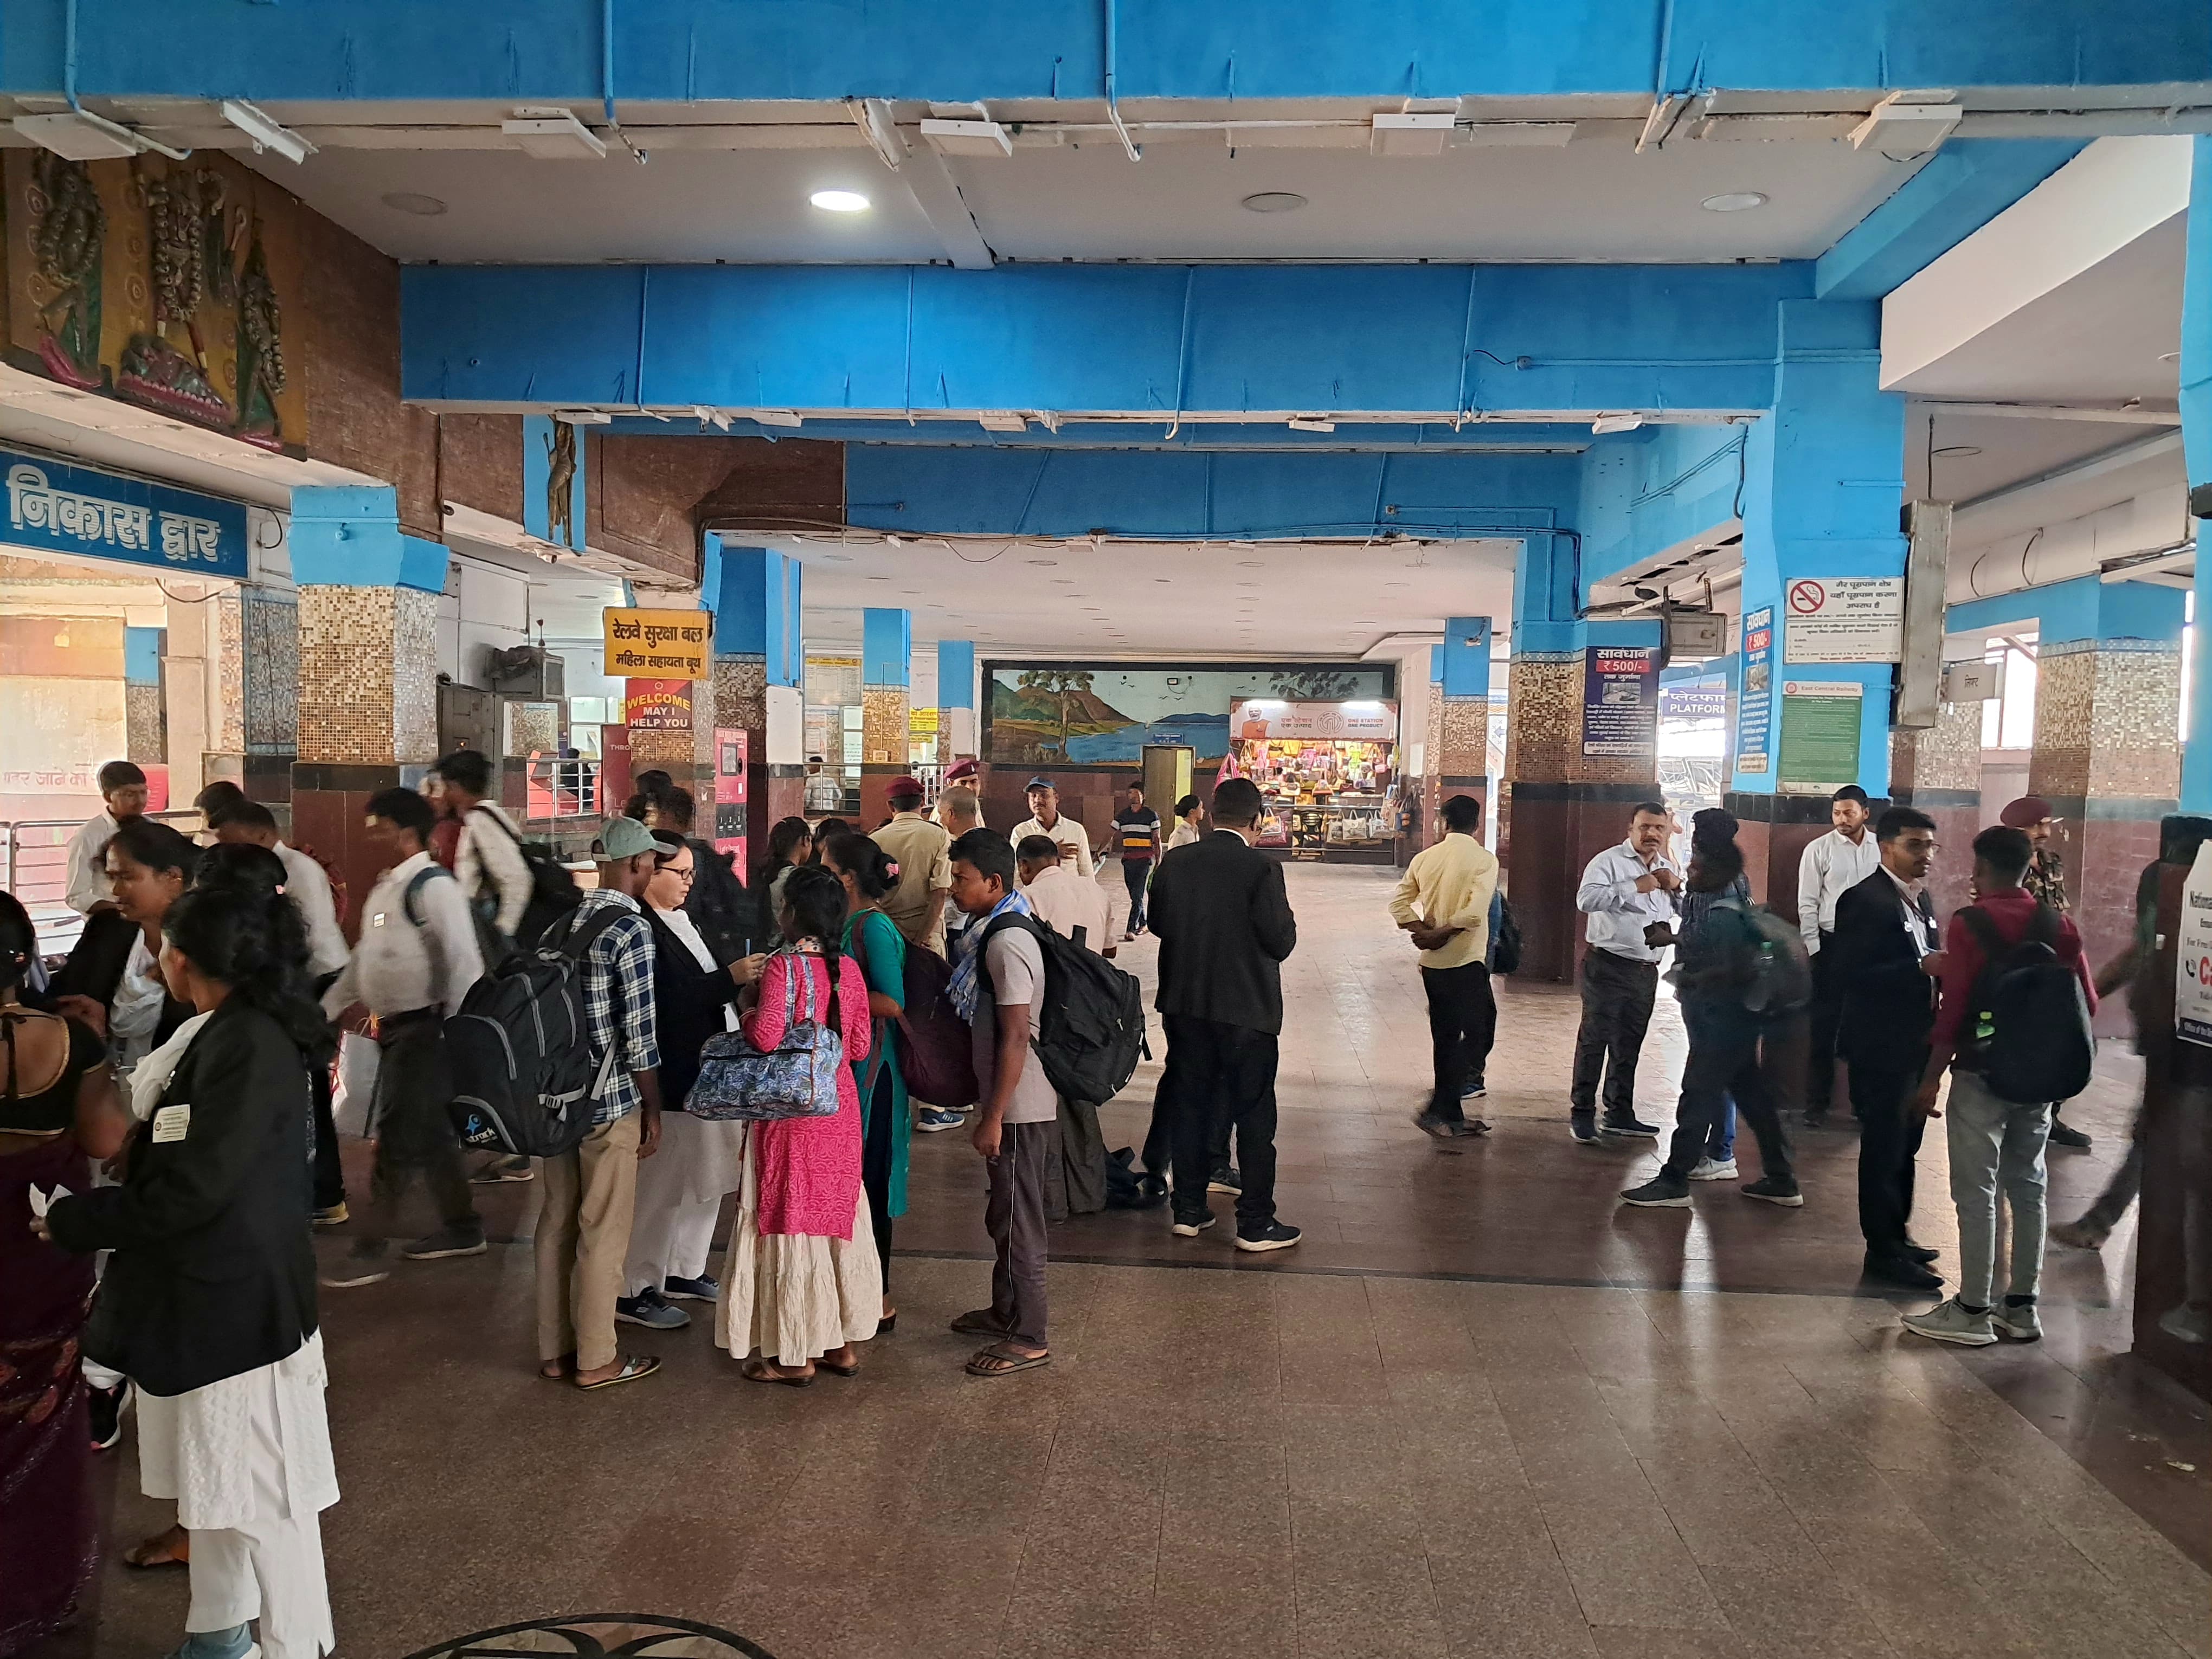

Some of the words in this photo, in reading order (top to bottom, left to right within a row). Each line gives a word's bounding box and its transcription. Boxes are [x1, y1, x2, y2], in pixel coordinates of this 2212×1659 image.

[6, 464, 152, 550] निकास
[159, 511, 221, 562] द्वार
[612, 618, 641, 639] रेलवे
[644, 625, 678, 648] सुरक्षा
[681, 627, 704, 642] बल
[616, 650, 646, 666] महिला
[648, 656, 684, 668] सहायता
[1613, 661, 1642, 671] 500/-
[627, 693, 691, 712] WELCOME
[643, 706, 667, 716] MAY
[671, 707, 675, 716] I
[630, 718, 660, 727] HELP
[664, 718, 688, 728] YOU
